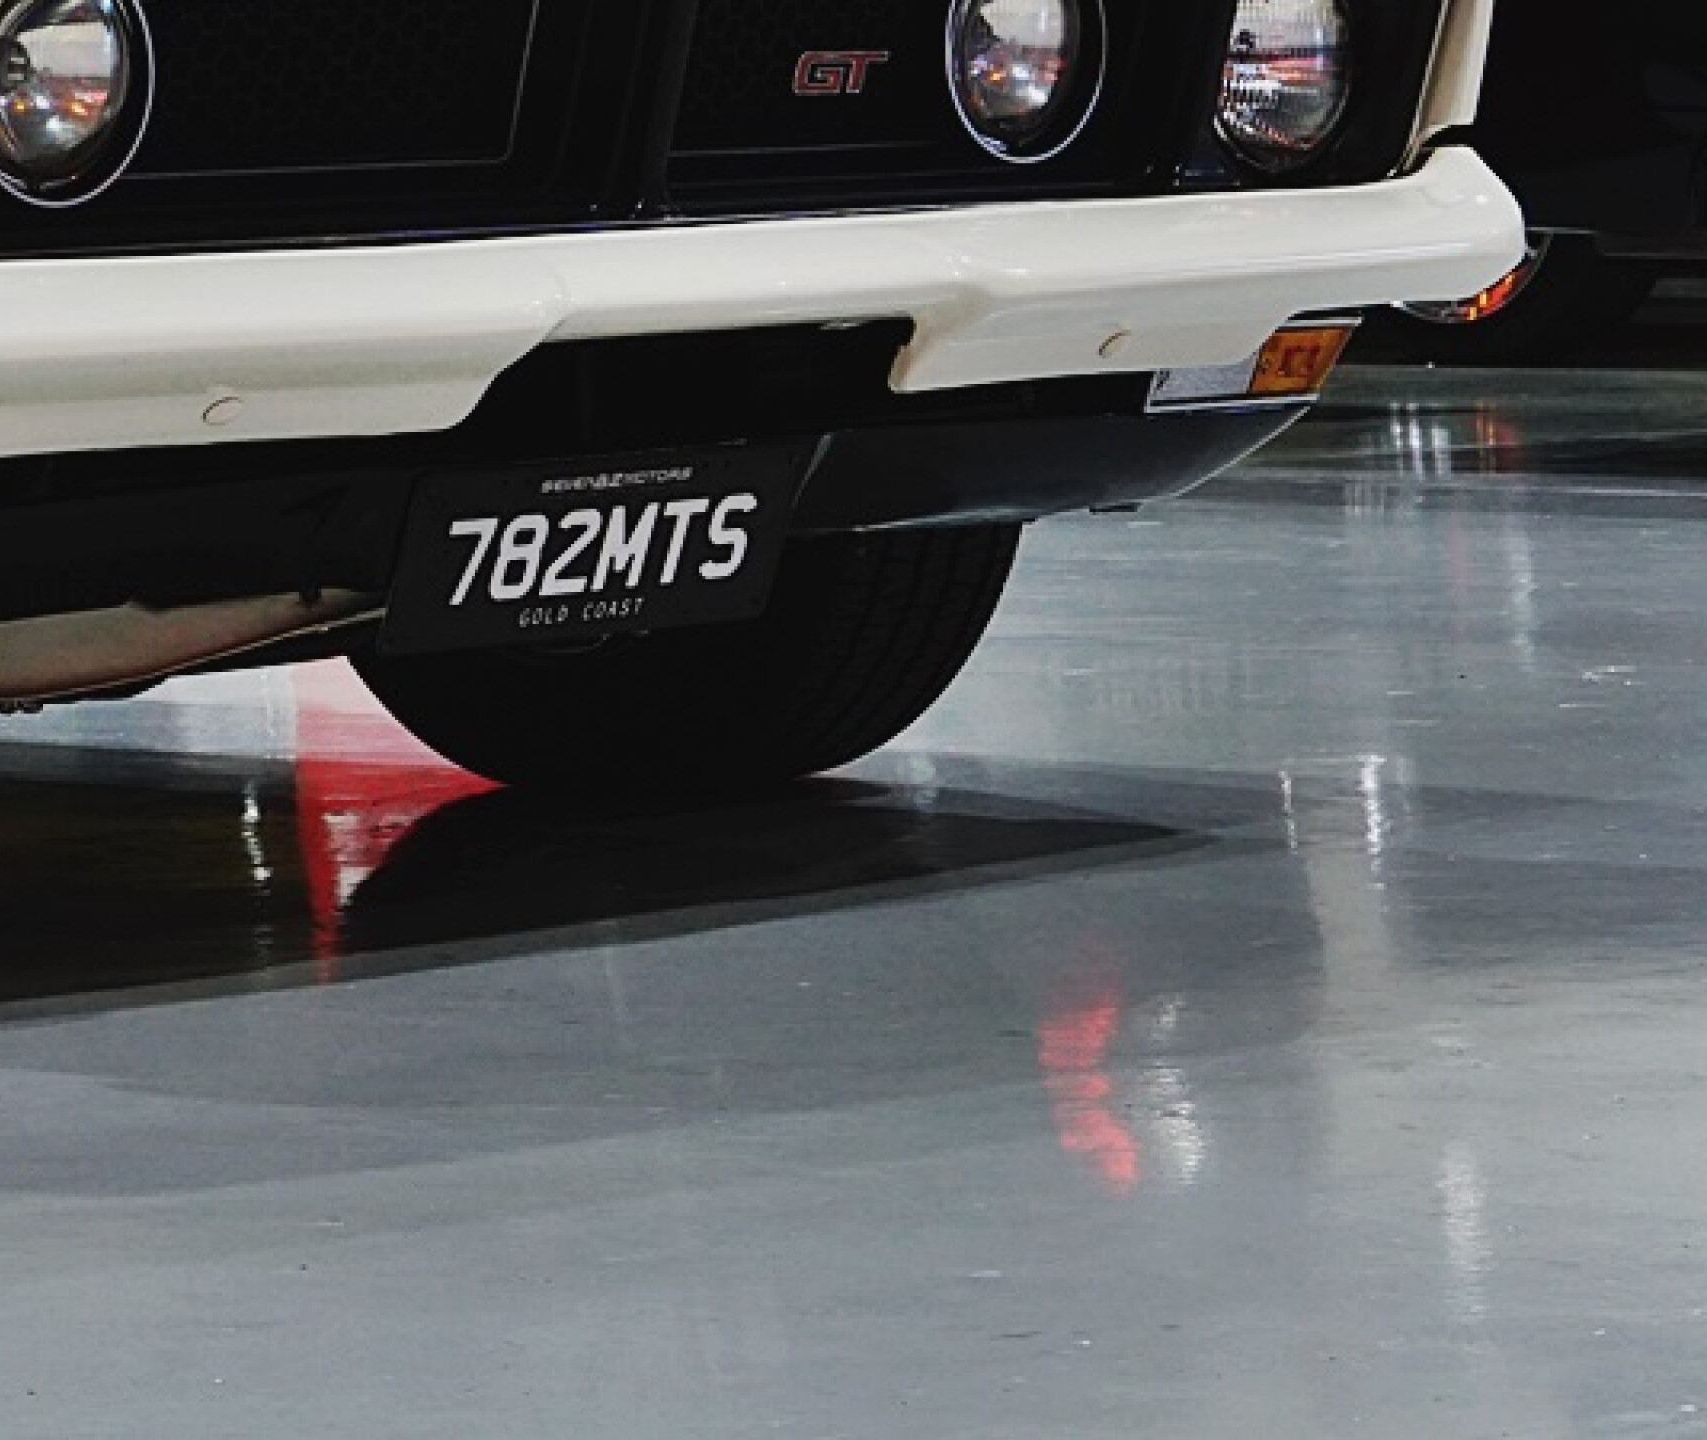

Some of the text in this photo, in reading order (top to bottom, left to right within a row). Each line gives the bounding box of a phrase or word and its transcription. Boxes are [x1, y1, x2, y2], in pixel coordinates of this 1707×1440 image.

[793, 50, 890, 95] GT
[448, 492, 758, 606] 782MTS
[519, 597, 645, 628] GOLD COAST
